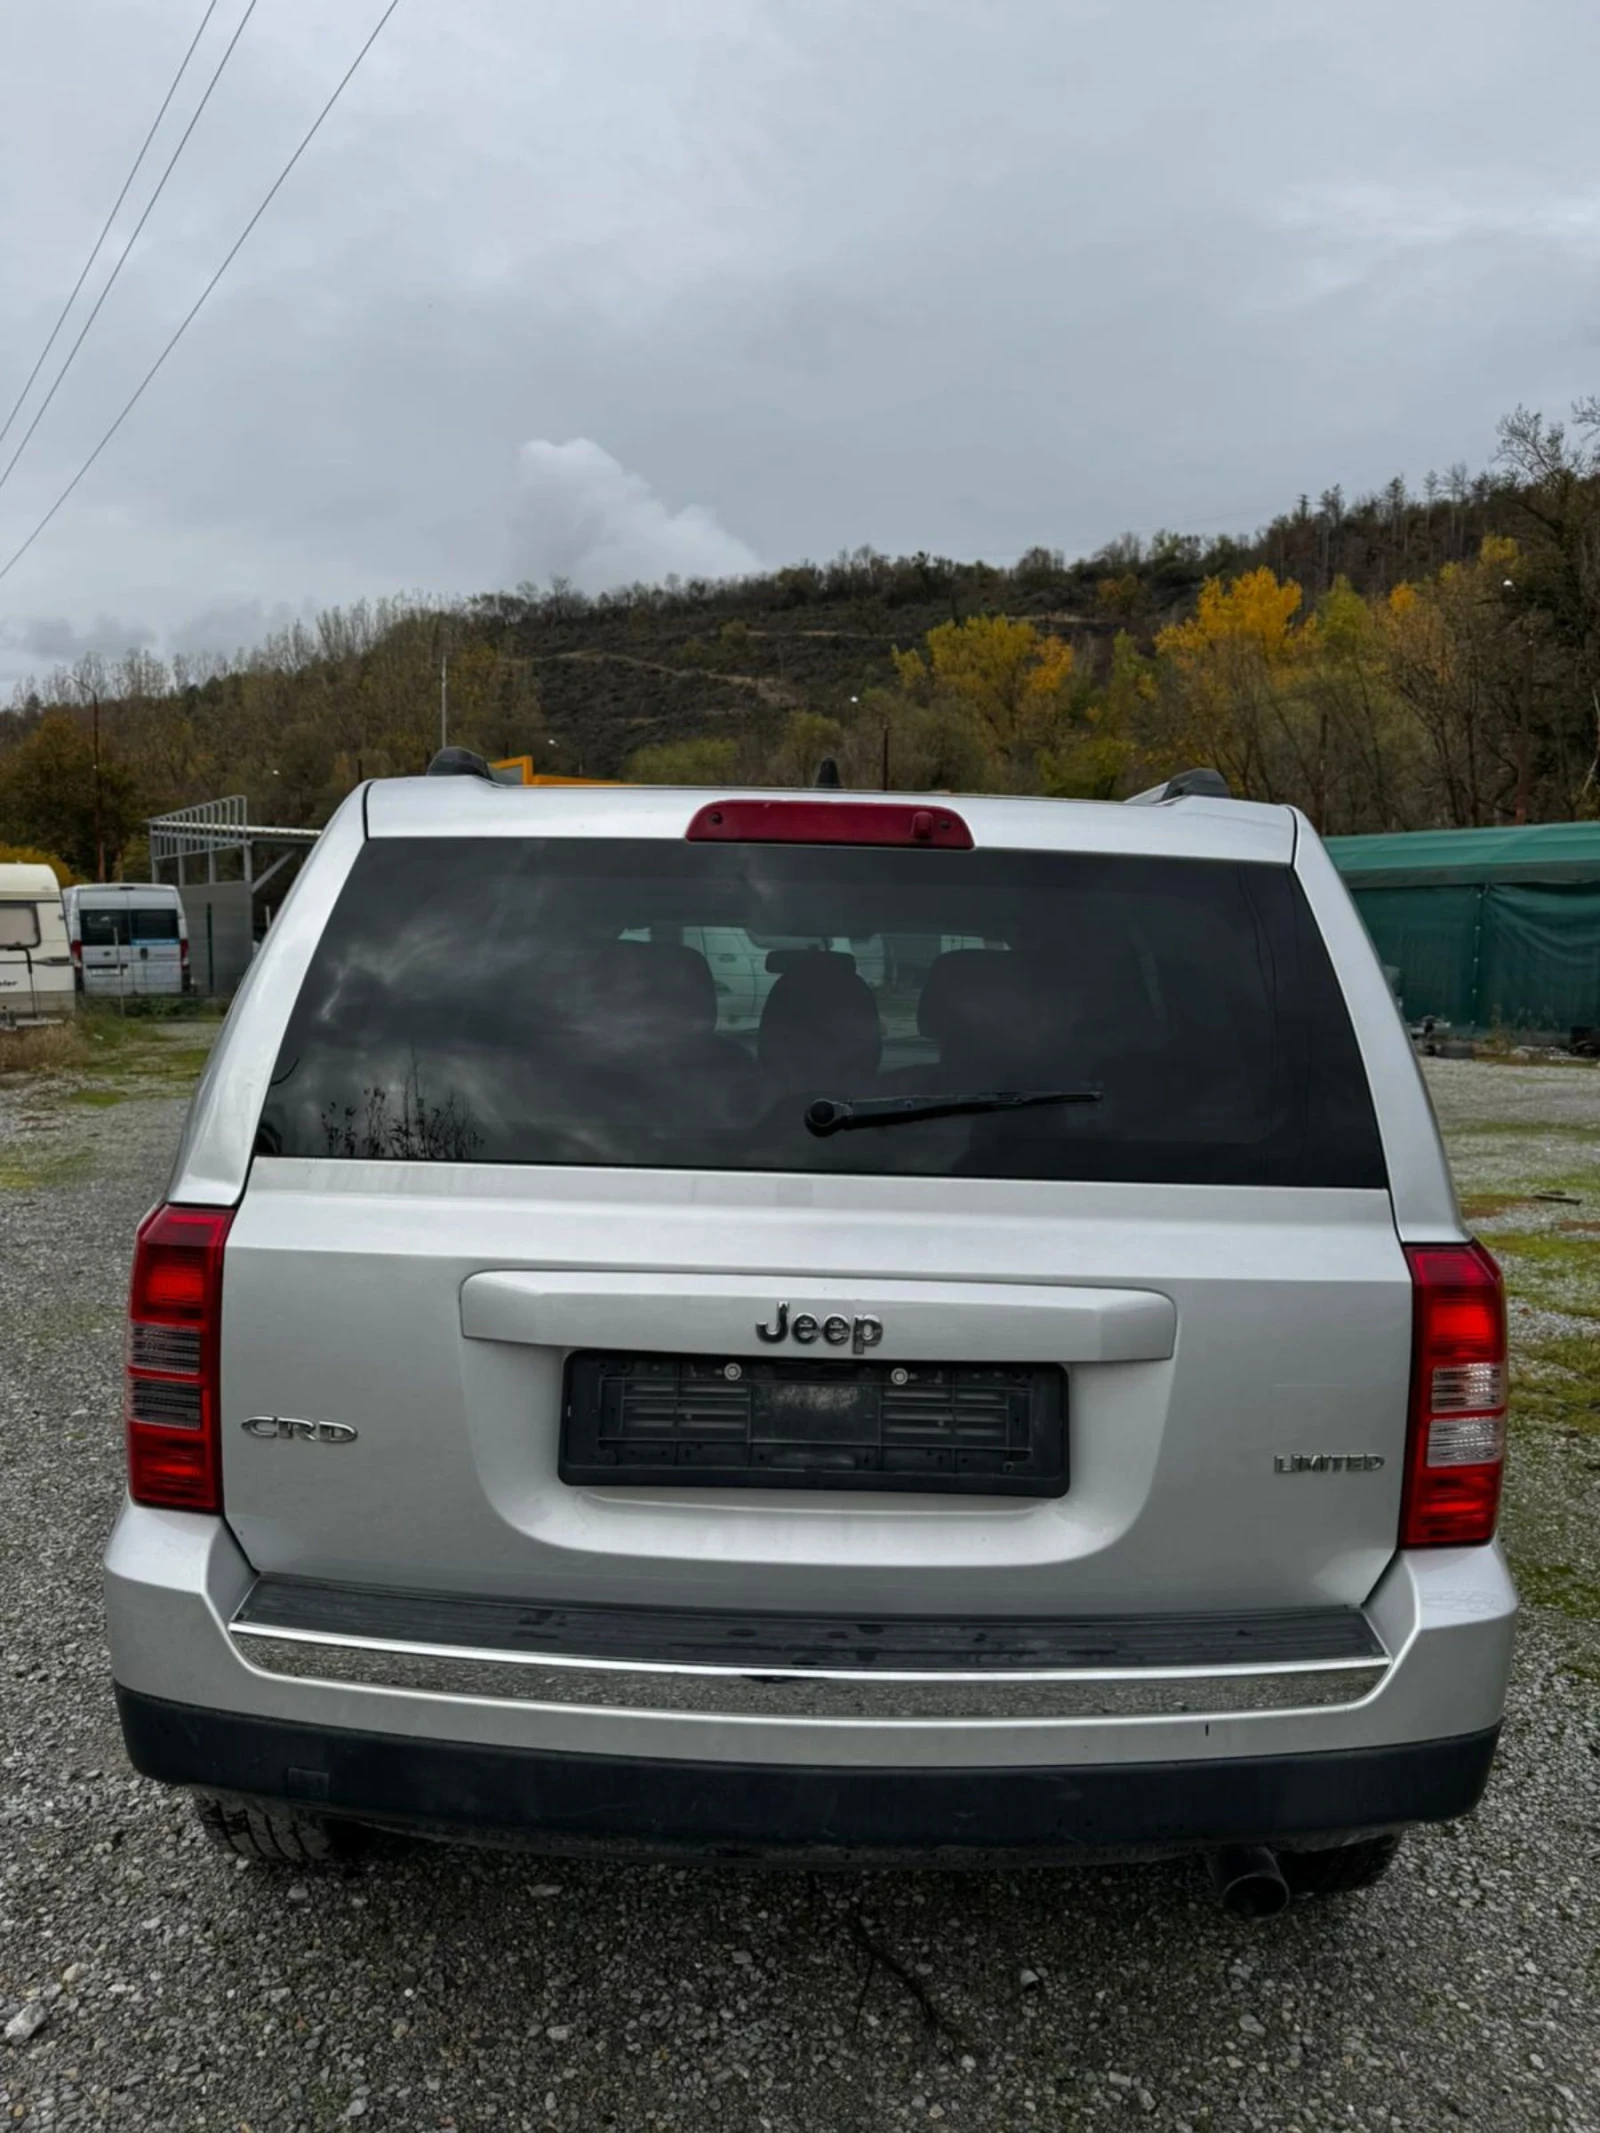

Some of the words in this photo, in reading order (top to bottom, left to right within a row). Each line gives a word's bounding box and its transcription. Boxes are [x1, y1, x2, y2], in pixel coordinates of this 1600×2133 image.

[756, 1300, 883, 1354] Jeep
[241, 1415, 358, 1444] CRD
[1274, 1453, 1385, 1473] LIMITED
